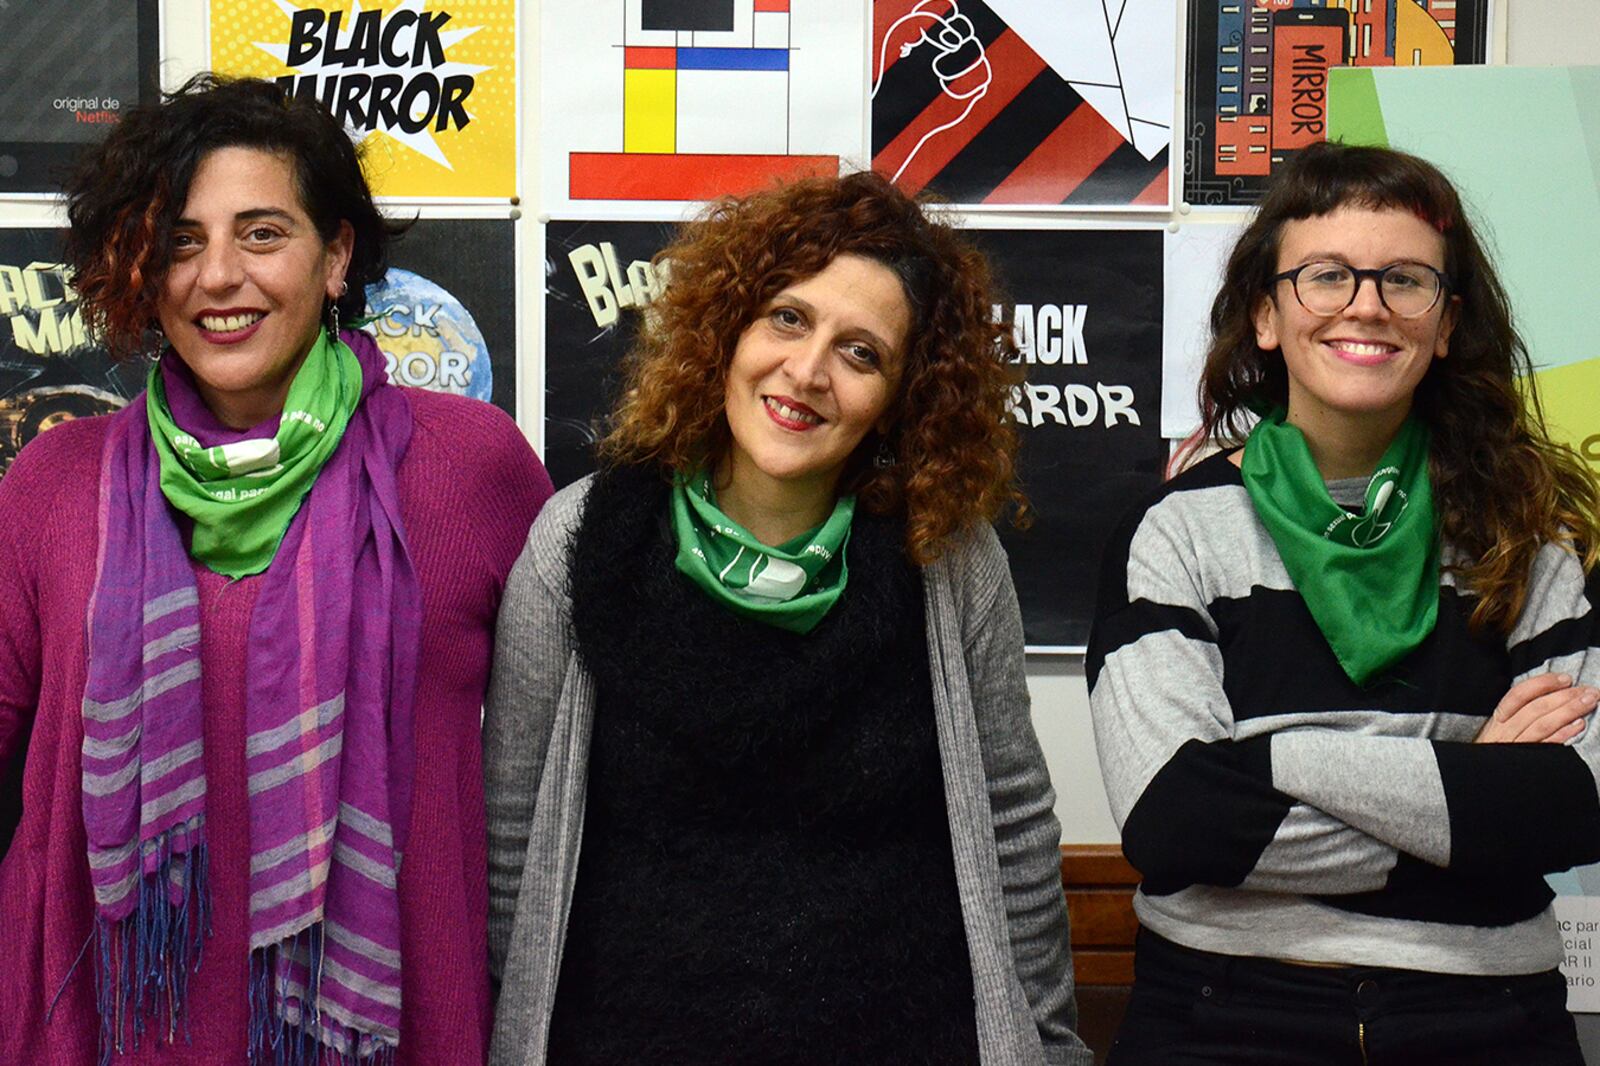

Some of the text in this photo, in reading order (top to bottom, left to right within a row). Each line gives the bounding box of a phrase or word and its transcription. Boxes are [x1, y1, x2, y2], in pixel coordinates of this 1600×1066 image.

[286, 8, 453, 69] BLACK
[53, 96, 120, 112] original de
[1290, 44, 1327, 135] MIRROR
